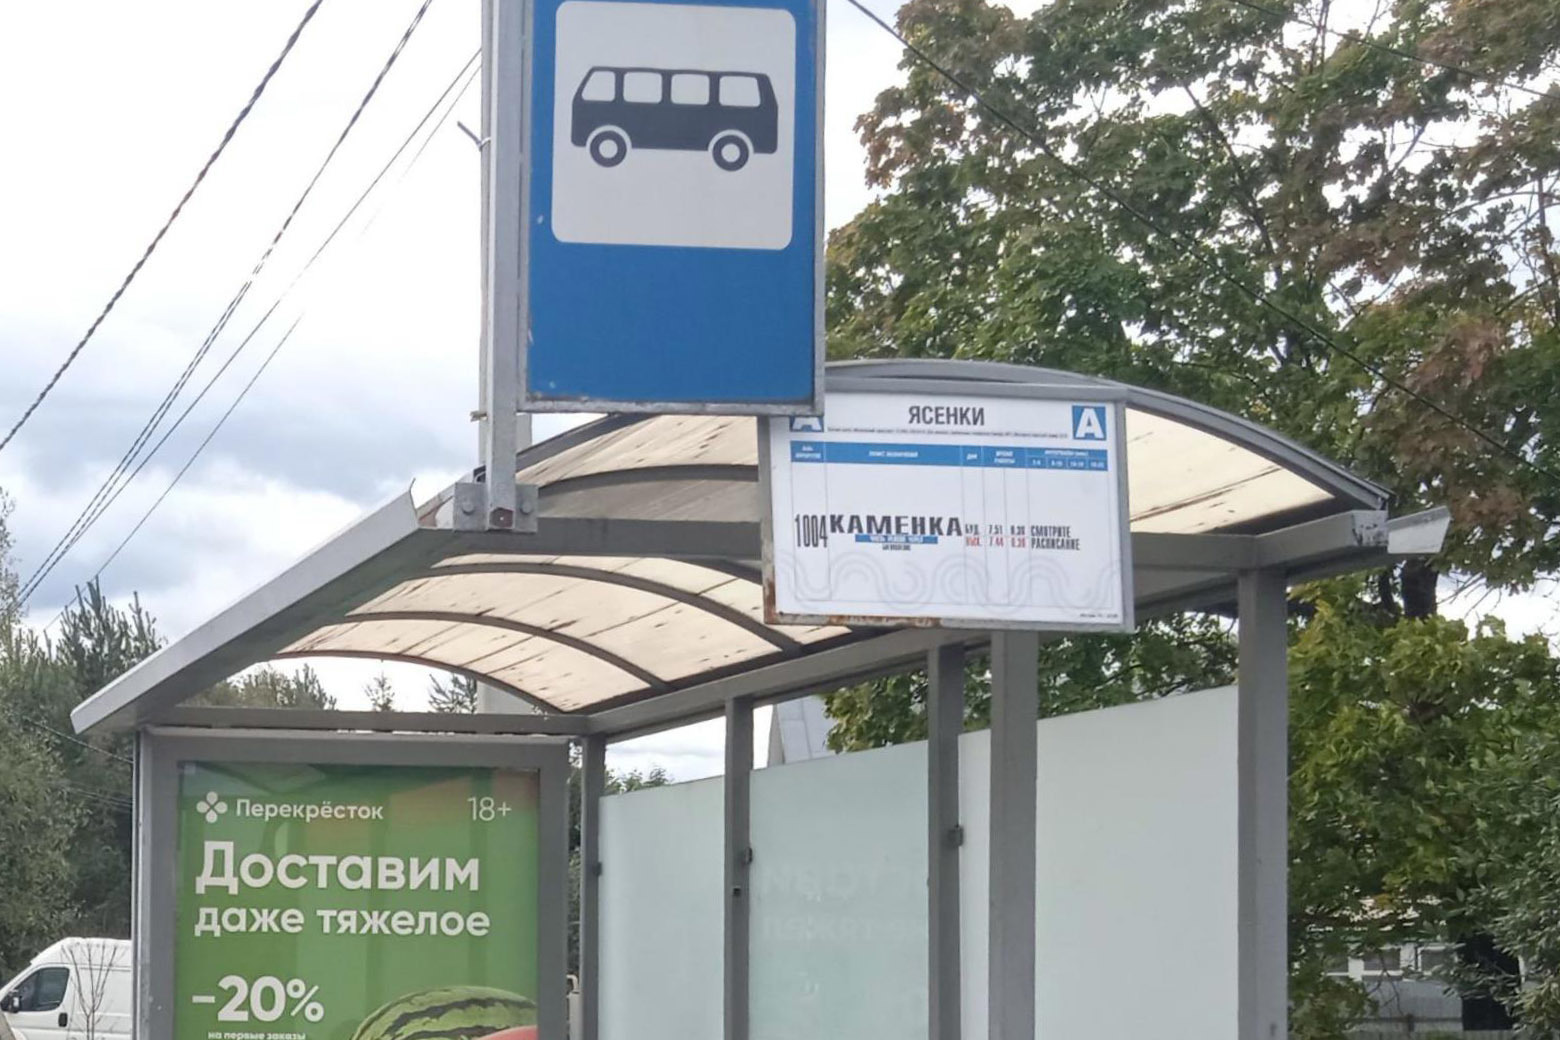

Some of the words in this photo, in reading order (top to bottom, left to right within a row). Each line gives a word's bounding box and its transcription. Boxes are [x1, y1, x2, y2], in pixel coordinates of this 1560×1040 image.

[908, 405, 985, 426] ЯСЕНКИ
[794, 514, 828, 548] 1004
[829, 514, 963, 536] КАМЕНКА
[236, 799, 384, 822] Перекрёсток
[467, 796, 512, 821] 18+
[196, 841, 480, 895] Доставим
[195, 906, 304, 937] даже
[317, 909, 491, 937] тяжелое
[192, 975, 325, 1023] -20%
[208, 1032, 223, 1040] на
[266, 1033, 307, 1040] заказы
